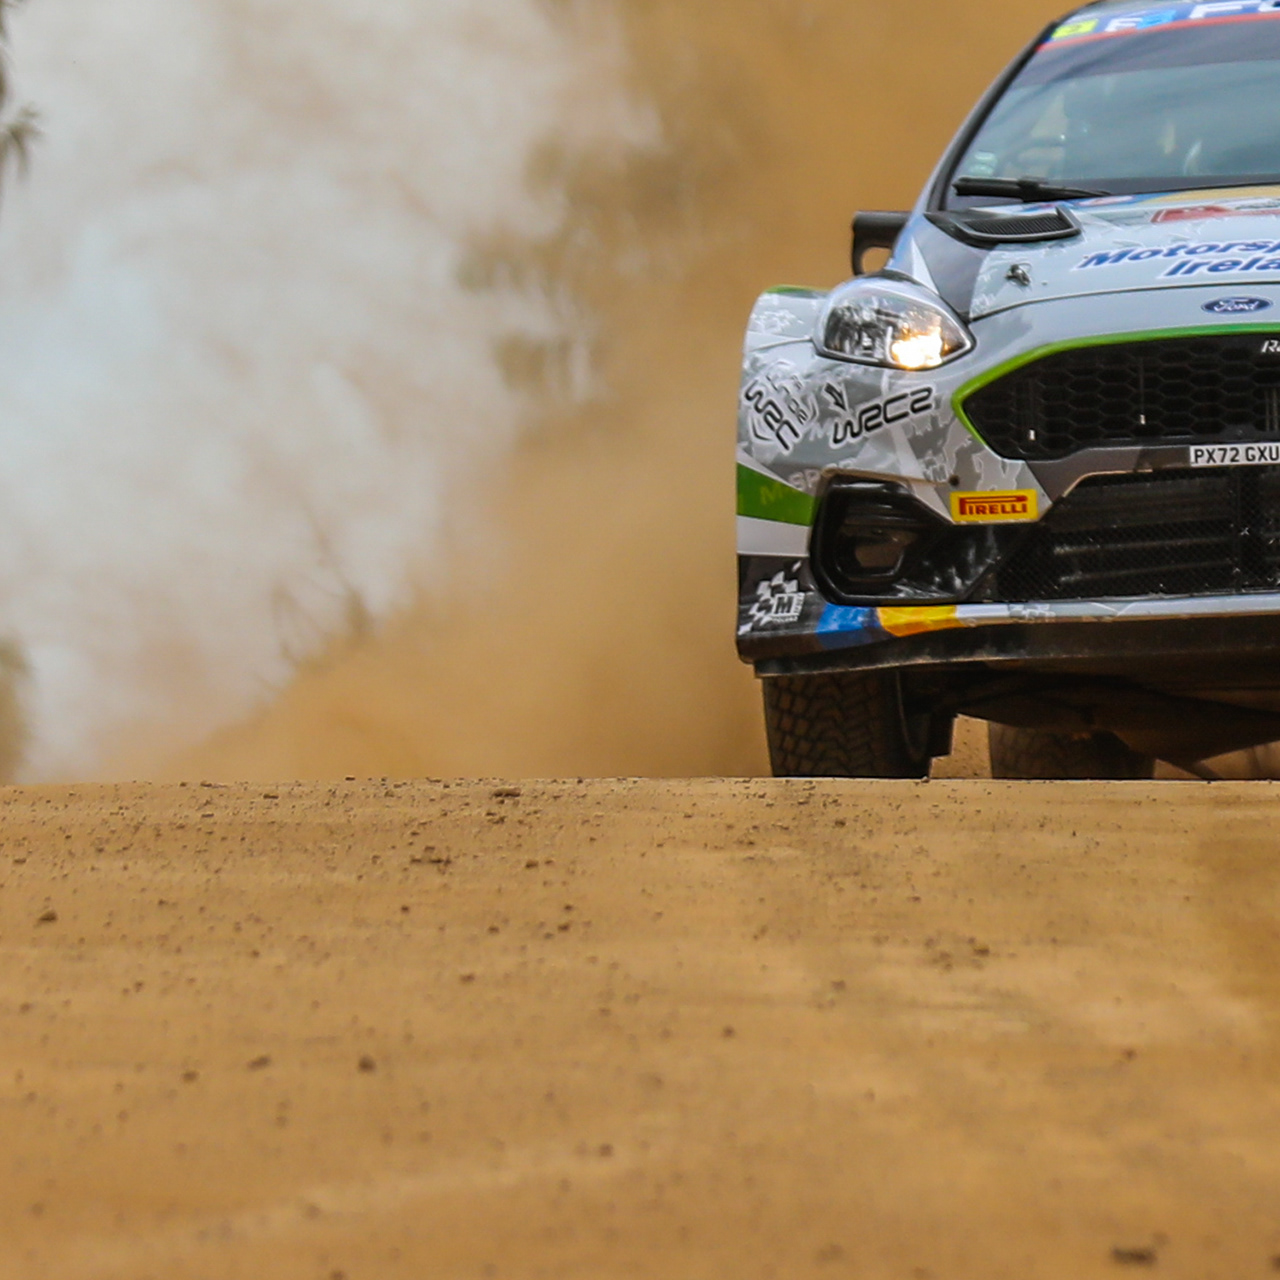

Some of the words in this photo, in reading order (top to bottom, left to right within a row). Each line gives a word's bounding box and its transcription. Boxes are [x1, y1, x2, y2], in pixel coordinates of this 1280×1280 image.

[1213, 298, 1260, 313] Ford
[744, 379, 801, 451] WRC
[832, 386, 934, 444] WRC2
[1193, 446, 1240, 464] PX72
[1245, 445, 1280, 462] GXU
[958, 495, 1028, 516] PIRELLI
